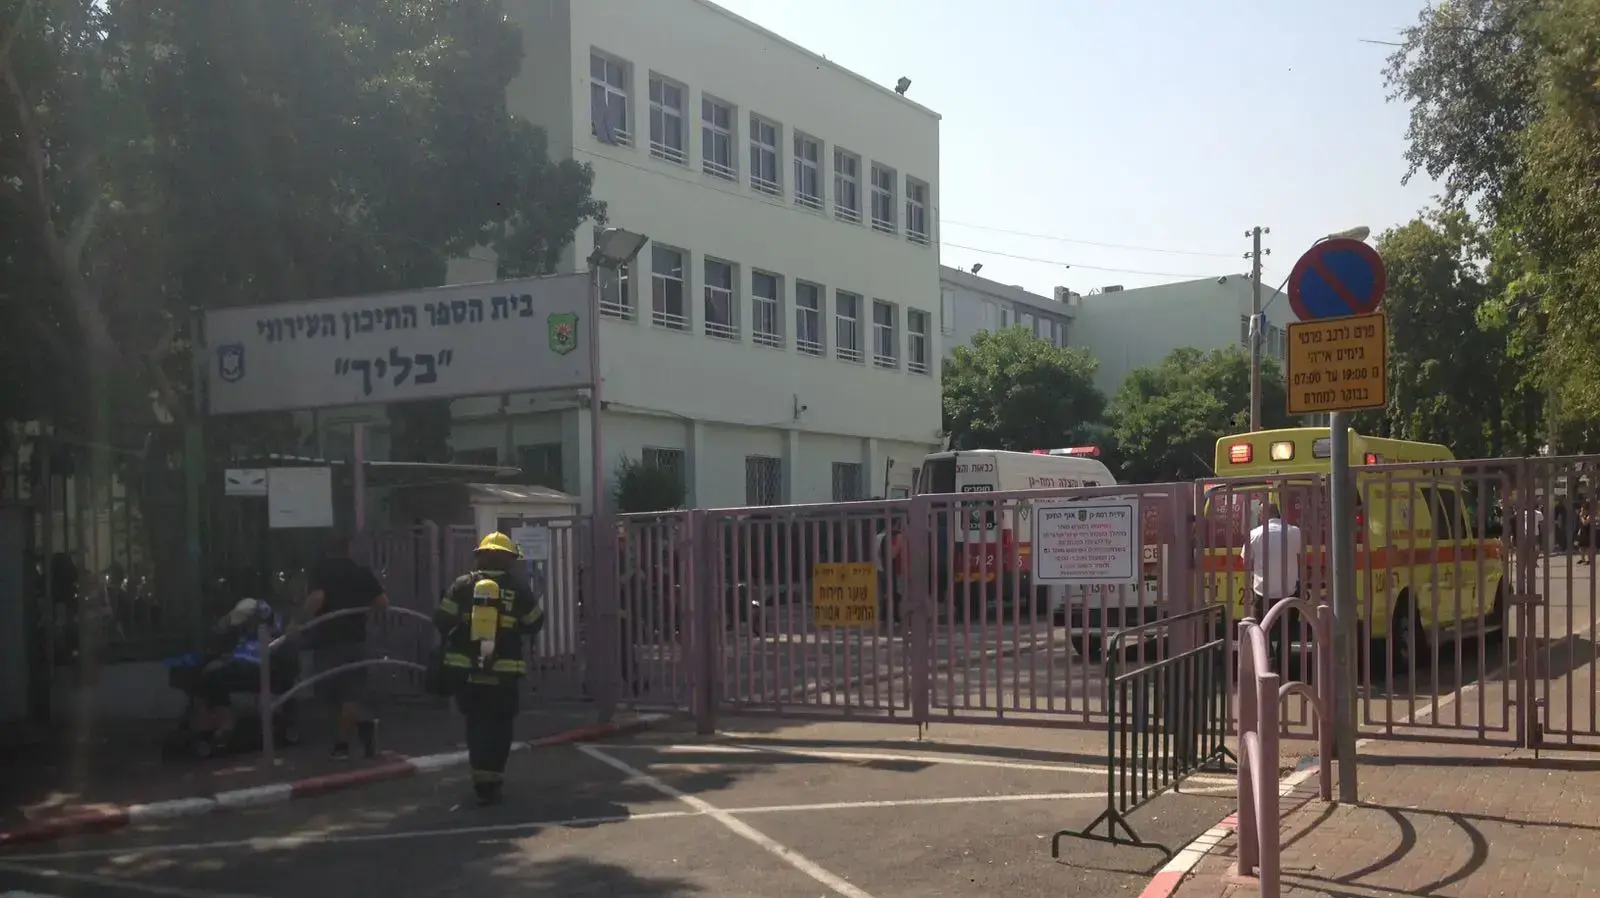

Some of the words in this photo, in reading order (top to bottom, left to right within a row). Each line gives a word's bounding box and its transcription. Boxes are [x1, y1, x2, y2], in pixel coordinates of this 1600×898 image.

[424, 299, 483, 327] הספר
[491, 293, 534, 321] בית
[257, 314, 336, 342] העירוני
[344, 305, 417, 340] התיכון
[1325, 370, 1338, 382] עד
